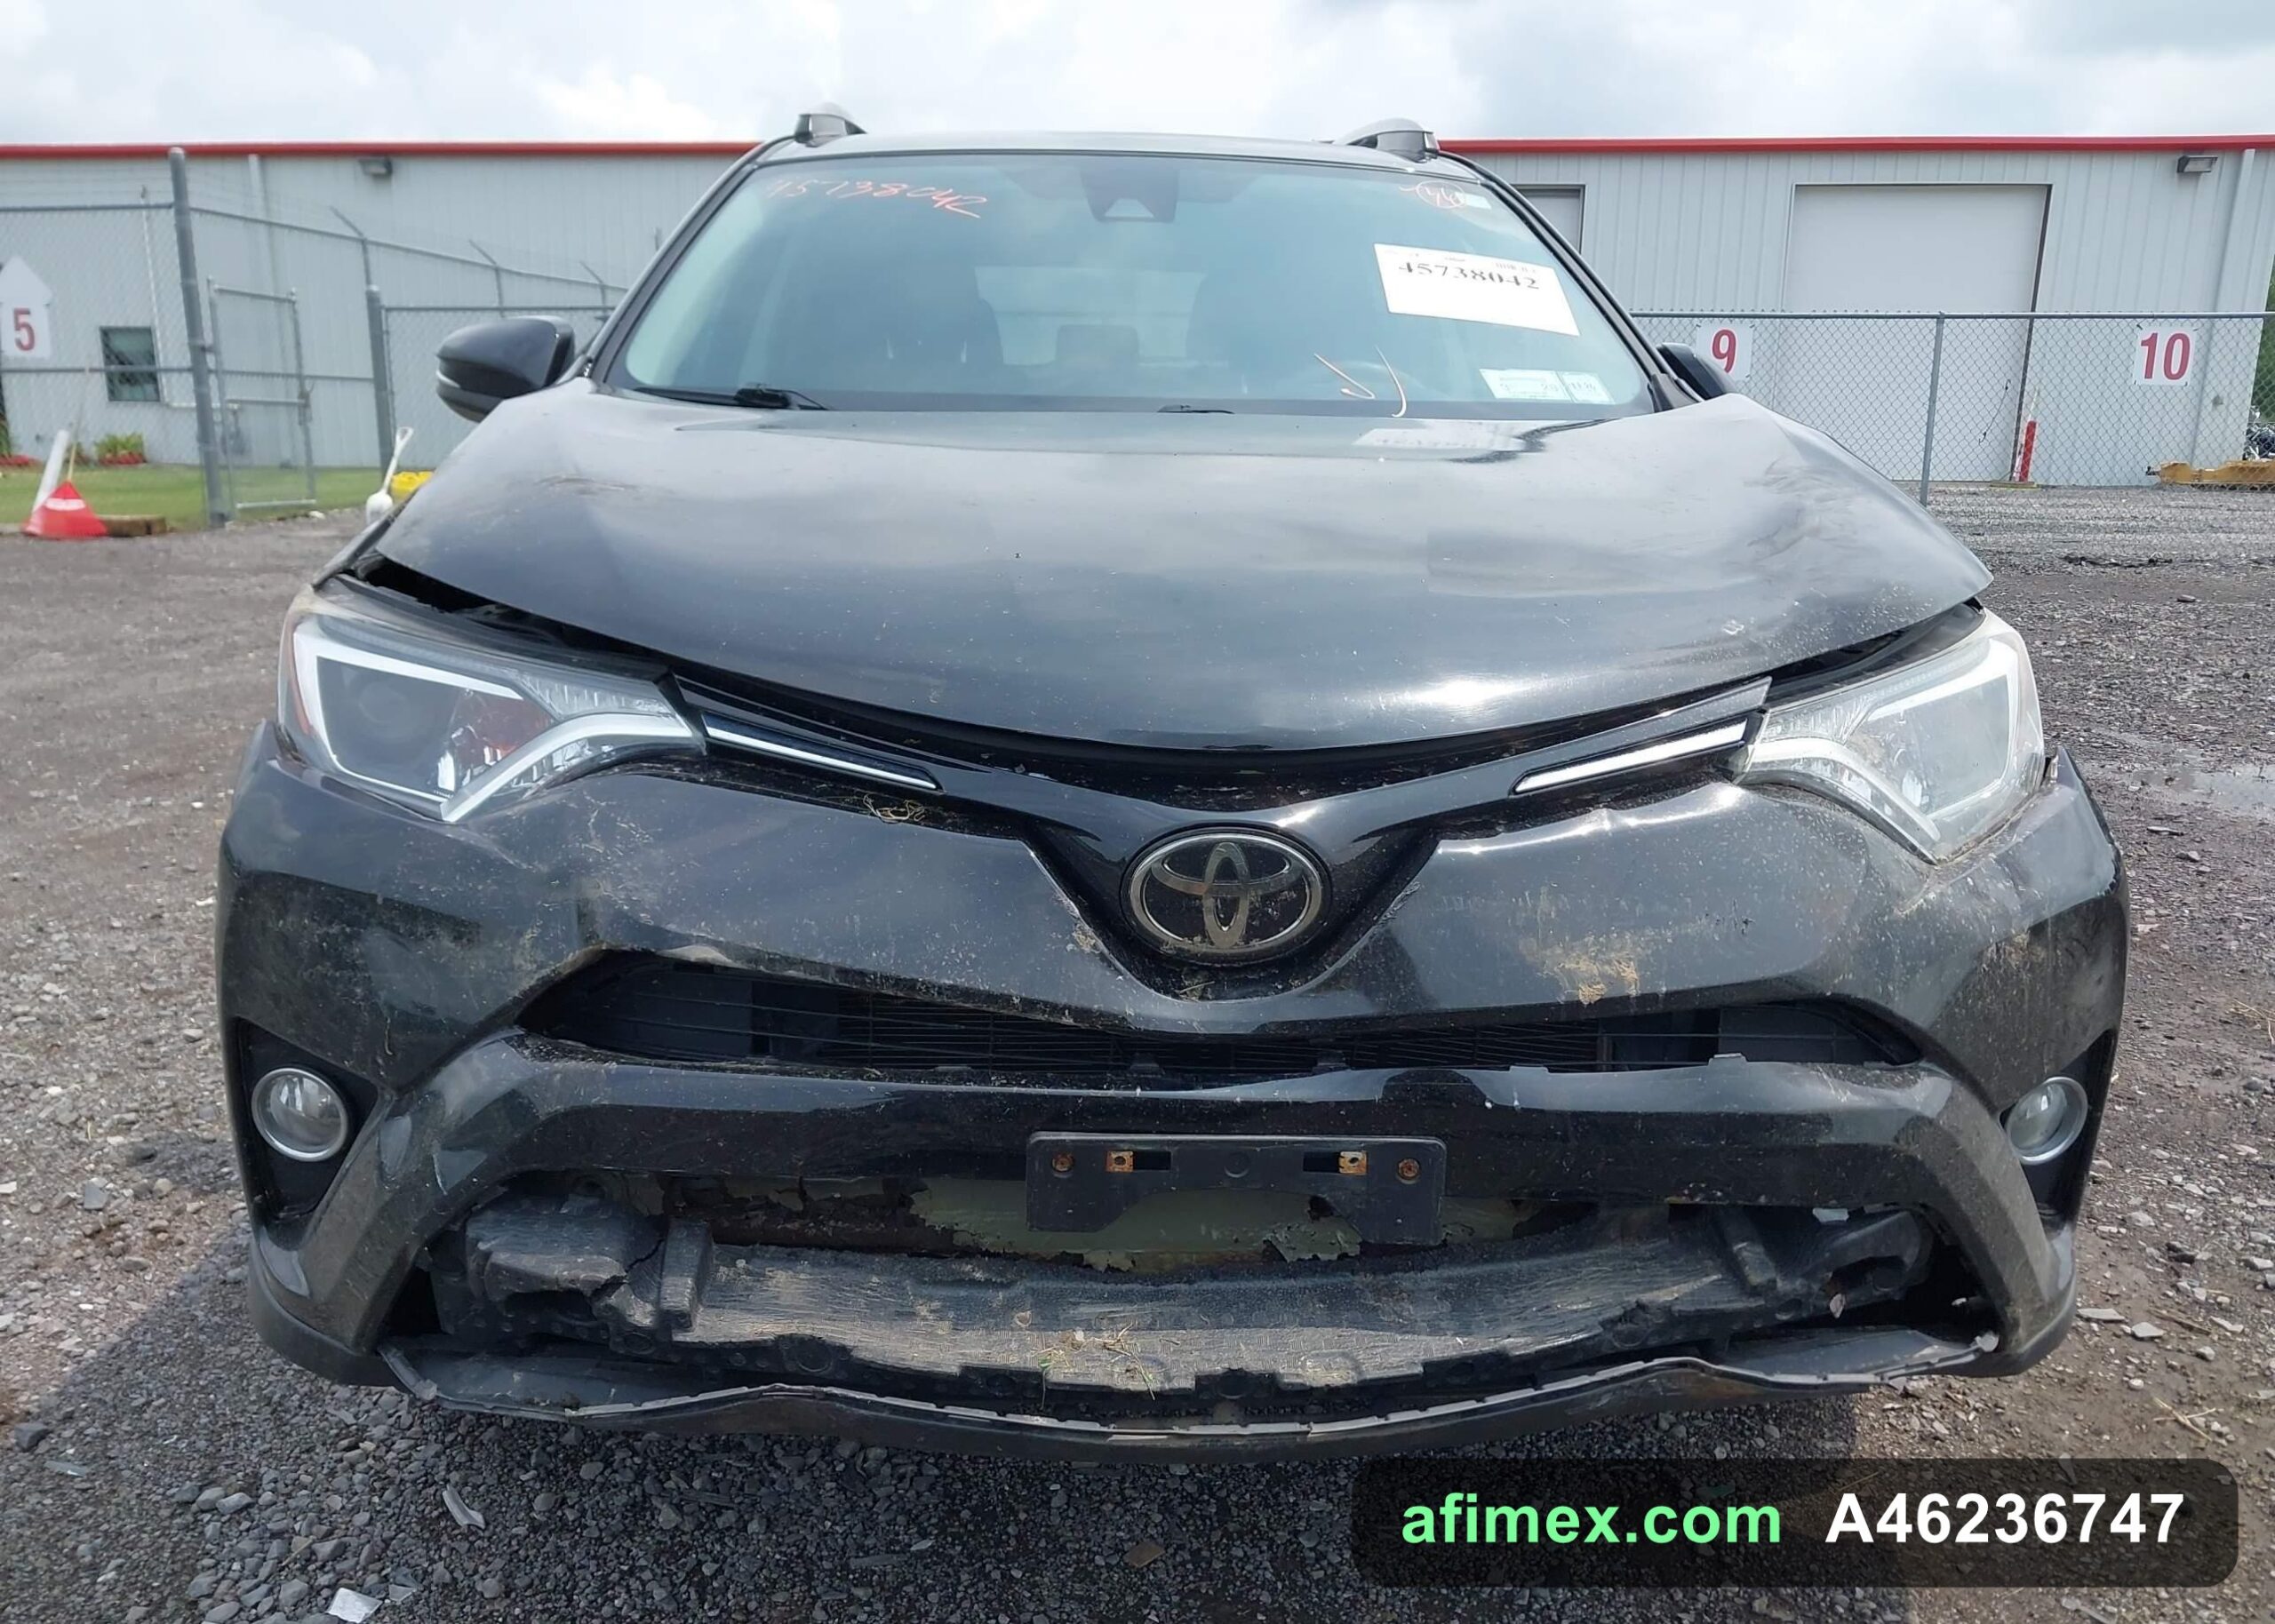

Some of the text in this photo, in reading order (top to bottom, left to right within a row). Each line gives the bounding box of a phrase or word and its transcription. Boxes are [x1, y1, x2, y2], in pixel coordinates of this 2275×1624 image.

[1398, 262, 1540, 290] 45738042
[13, 307, 36, 352] 5
[1712, 329, 1736, 374] 9
[2140, 332, 2191, 380] 10
